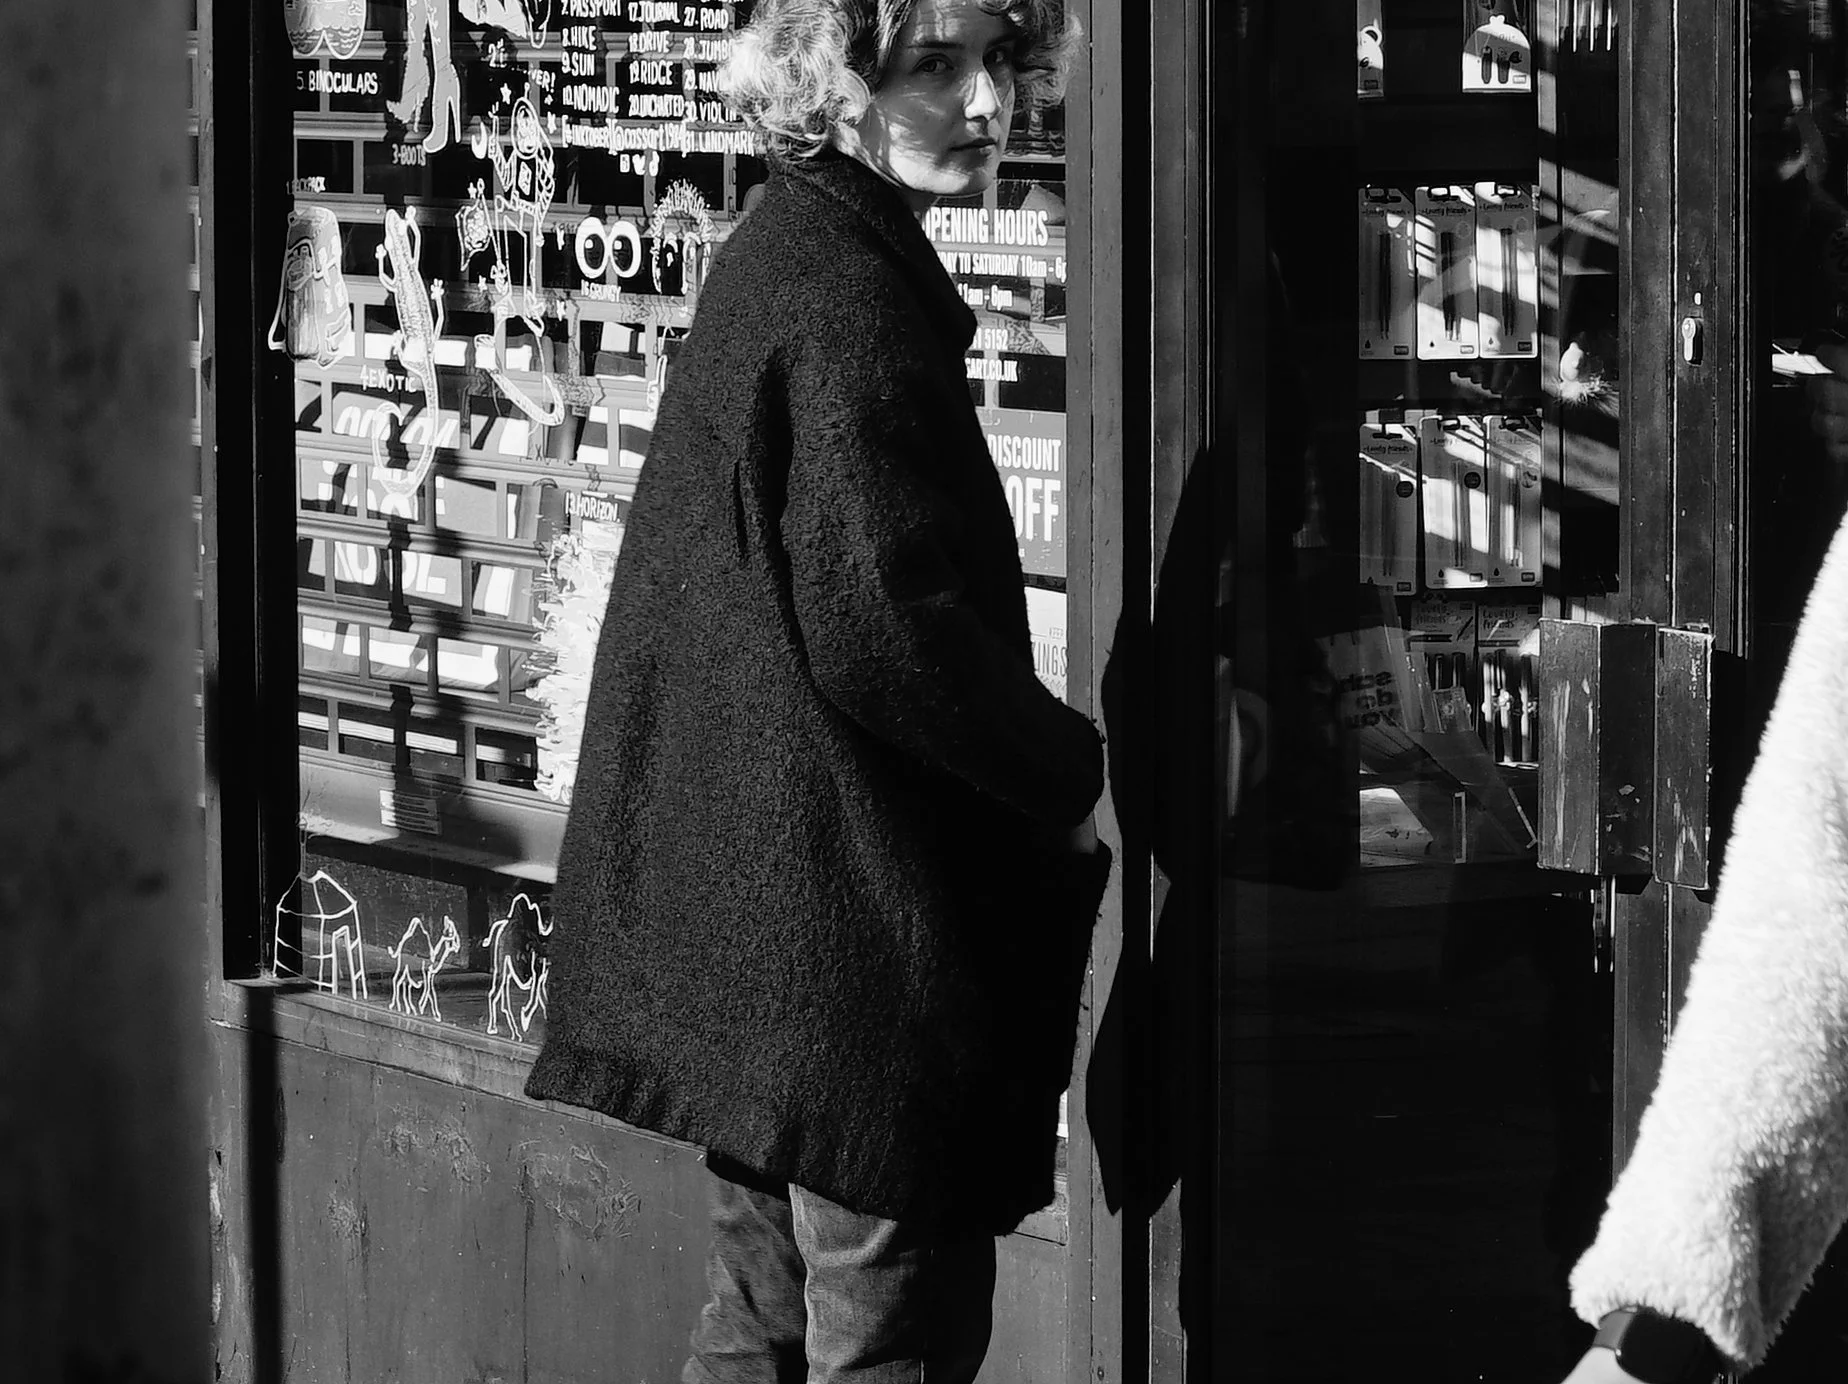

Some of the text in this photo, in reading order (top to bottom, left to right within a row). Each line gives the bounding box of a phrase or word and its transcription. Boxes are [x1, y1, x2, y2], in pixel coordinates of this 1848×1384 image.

[700, 7, 730, 32] ROAD
[571, 24, 598, 51] HIKE
[639, 29, 671, 54] DRIVE
[571, 50, 595, 77] SUN
[640, 58, 675, 86] RIDGE
[308, 69, 379, 95] BINOCULARS
[573, 82, 621, 114] NOMADIC
[699, 128, 756, 157] LANDMARK
[922, 206, 1048, 246] OPENING HOURS
[958, 251, 972, 275] TO
[972, 252, 1019, 277] SATURDAY
[1020, 254, 1047, 278] 10am
[991, 283, 1013, 311] 6pm
[983, 327, 1009, 351] 5152
[368, 367, 418, 393] EXOTIC
[964, 357, 1019, 383] SART.CO.UK
[987, 433, 1062, 473] DISCOUNT
[1005, 474, 1062, 542] OFF
[1032, 641, 1067, 678] INGS
